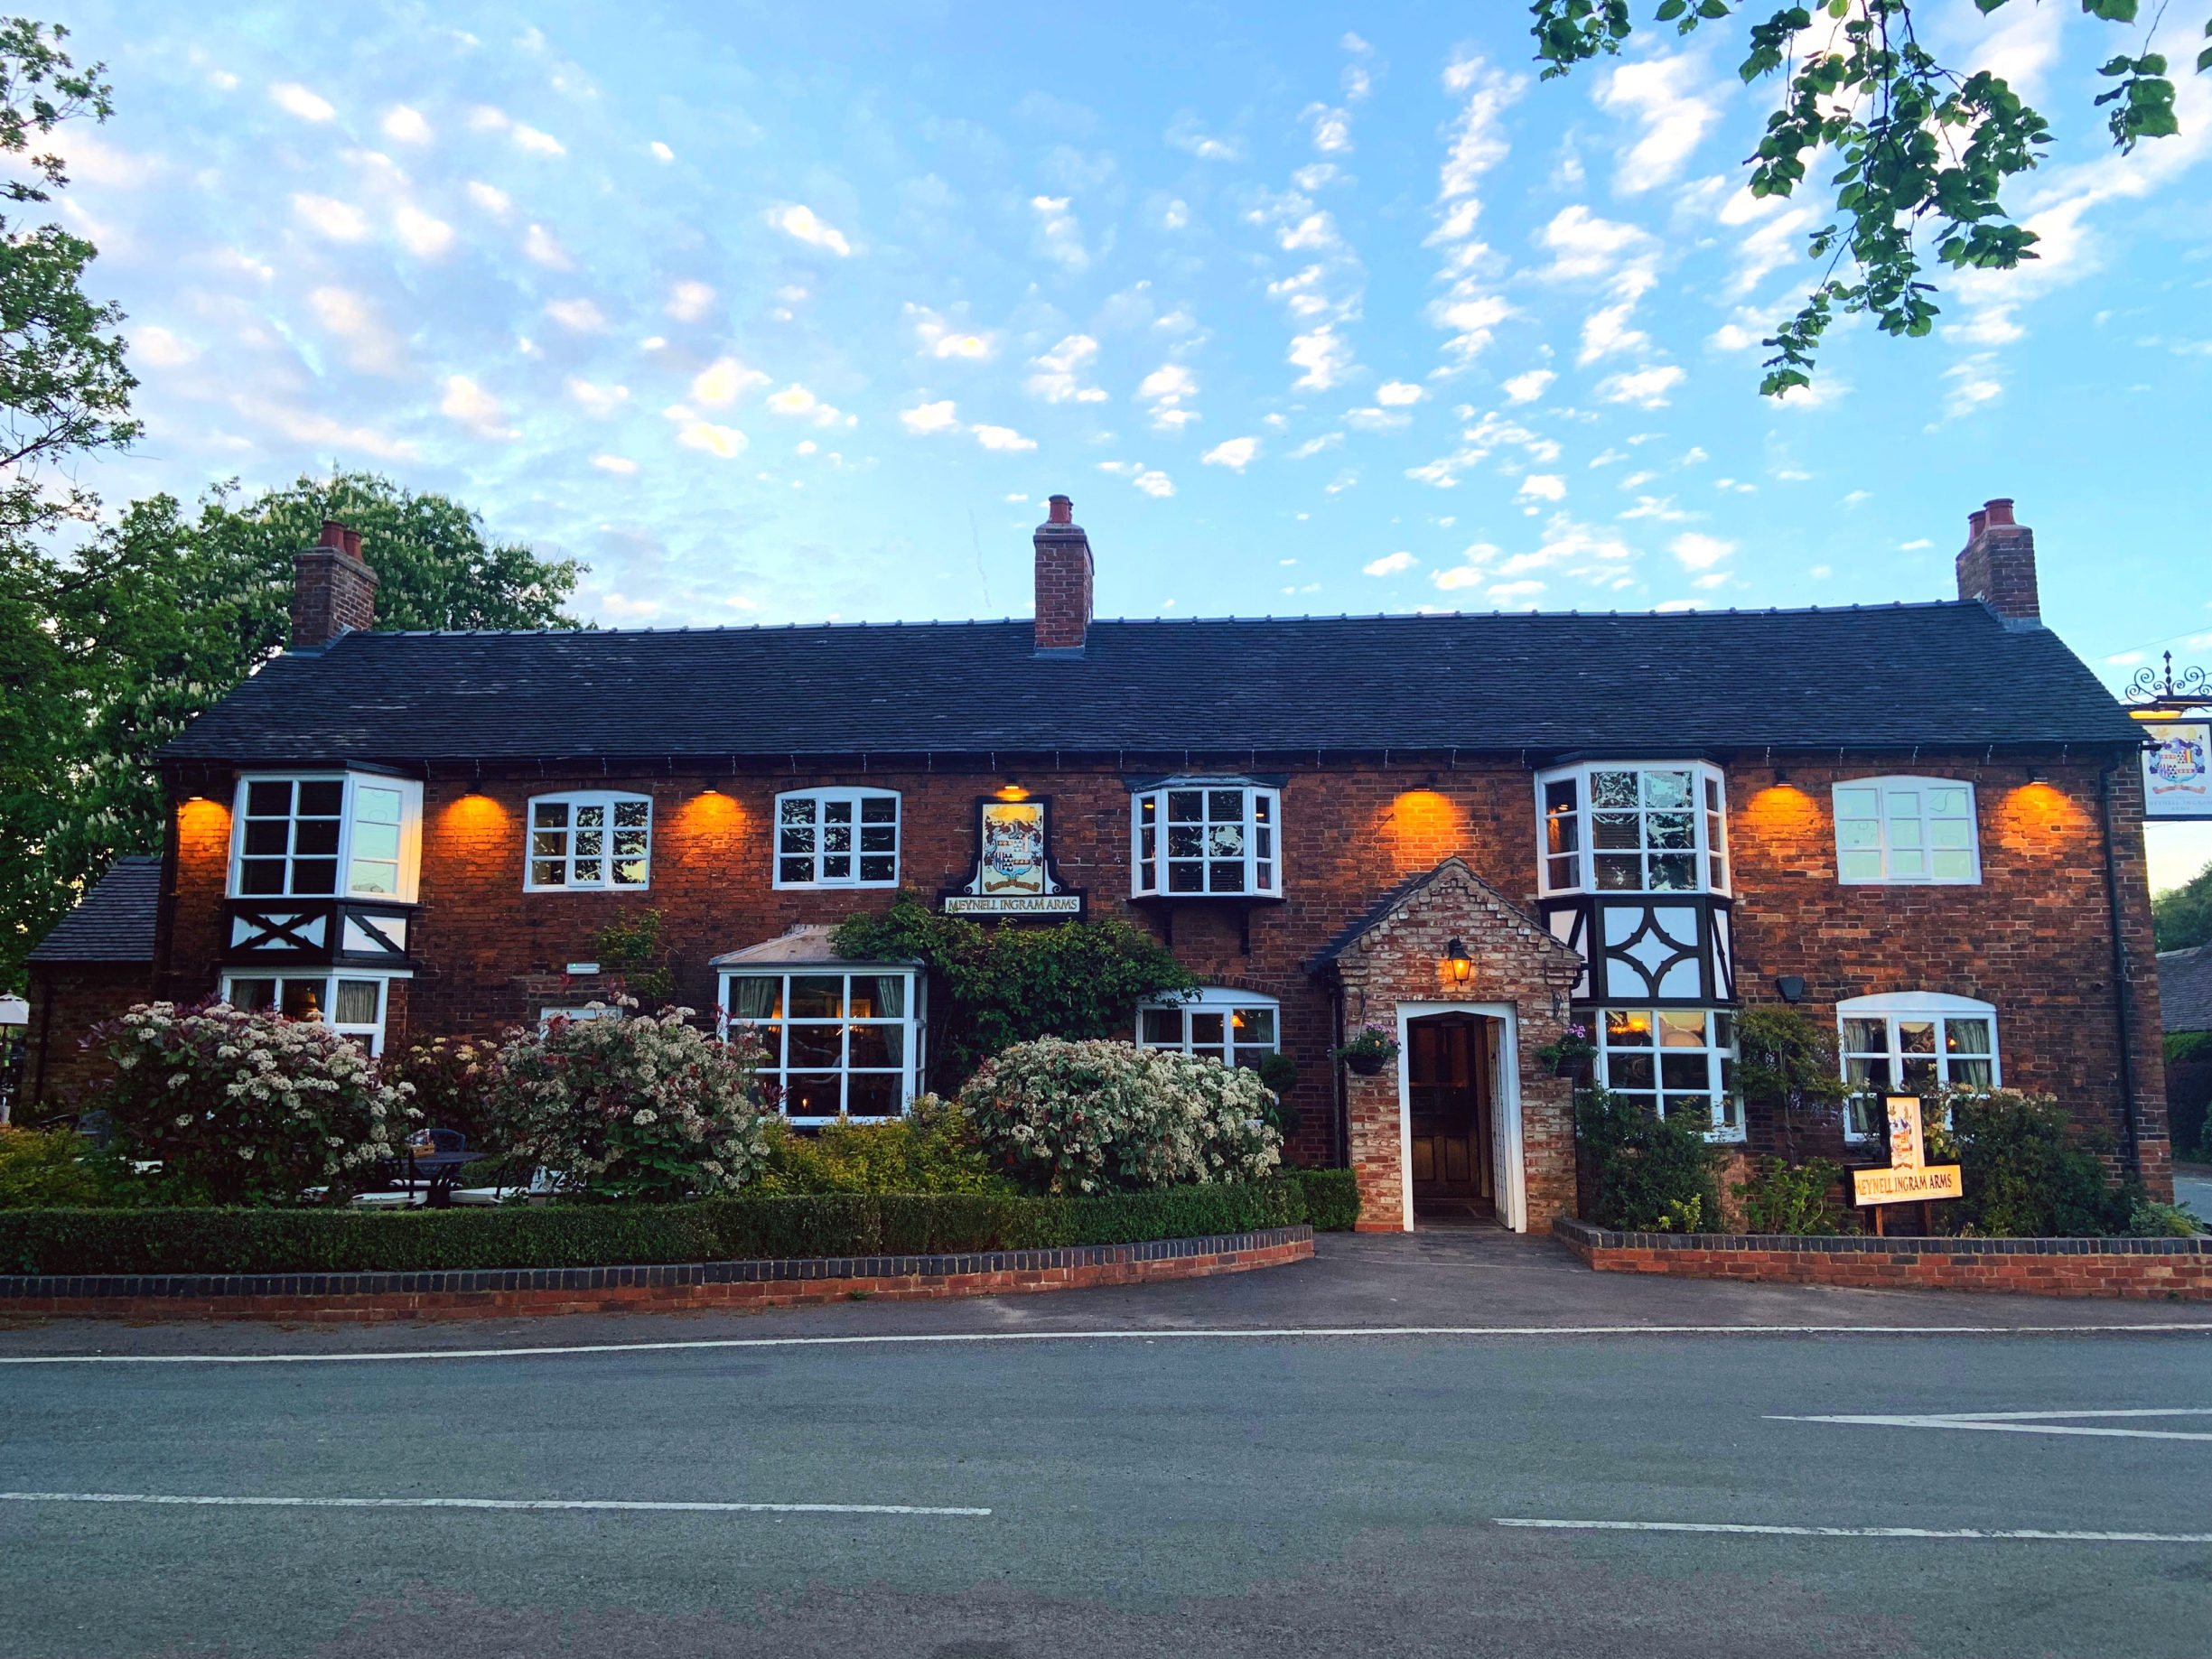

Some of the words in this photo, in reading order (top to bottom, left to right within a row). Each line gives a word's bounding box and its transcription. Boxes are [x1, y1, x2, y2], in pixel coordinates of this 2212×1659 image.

[948, 899, 998, 910] MEYNELL
[1000, 899, 1045, 910] INGRAM
[1046, 899, 1078, 910] ARMS
[1894, 1175, 1927, 1193] INGRAM
[1929, 1173, 1952, 1189] ARMS
